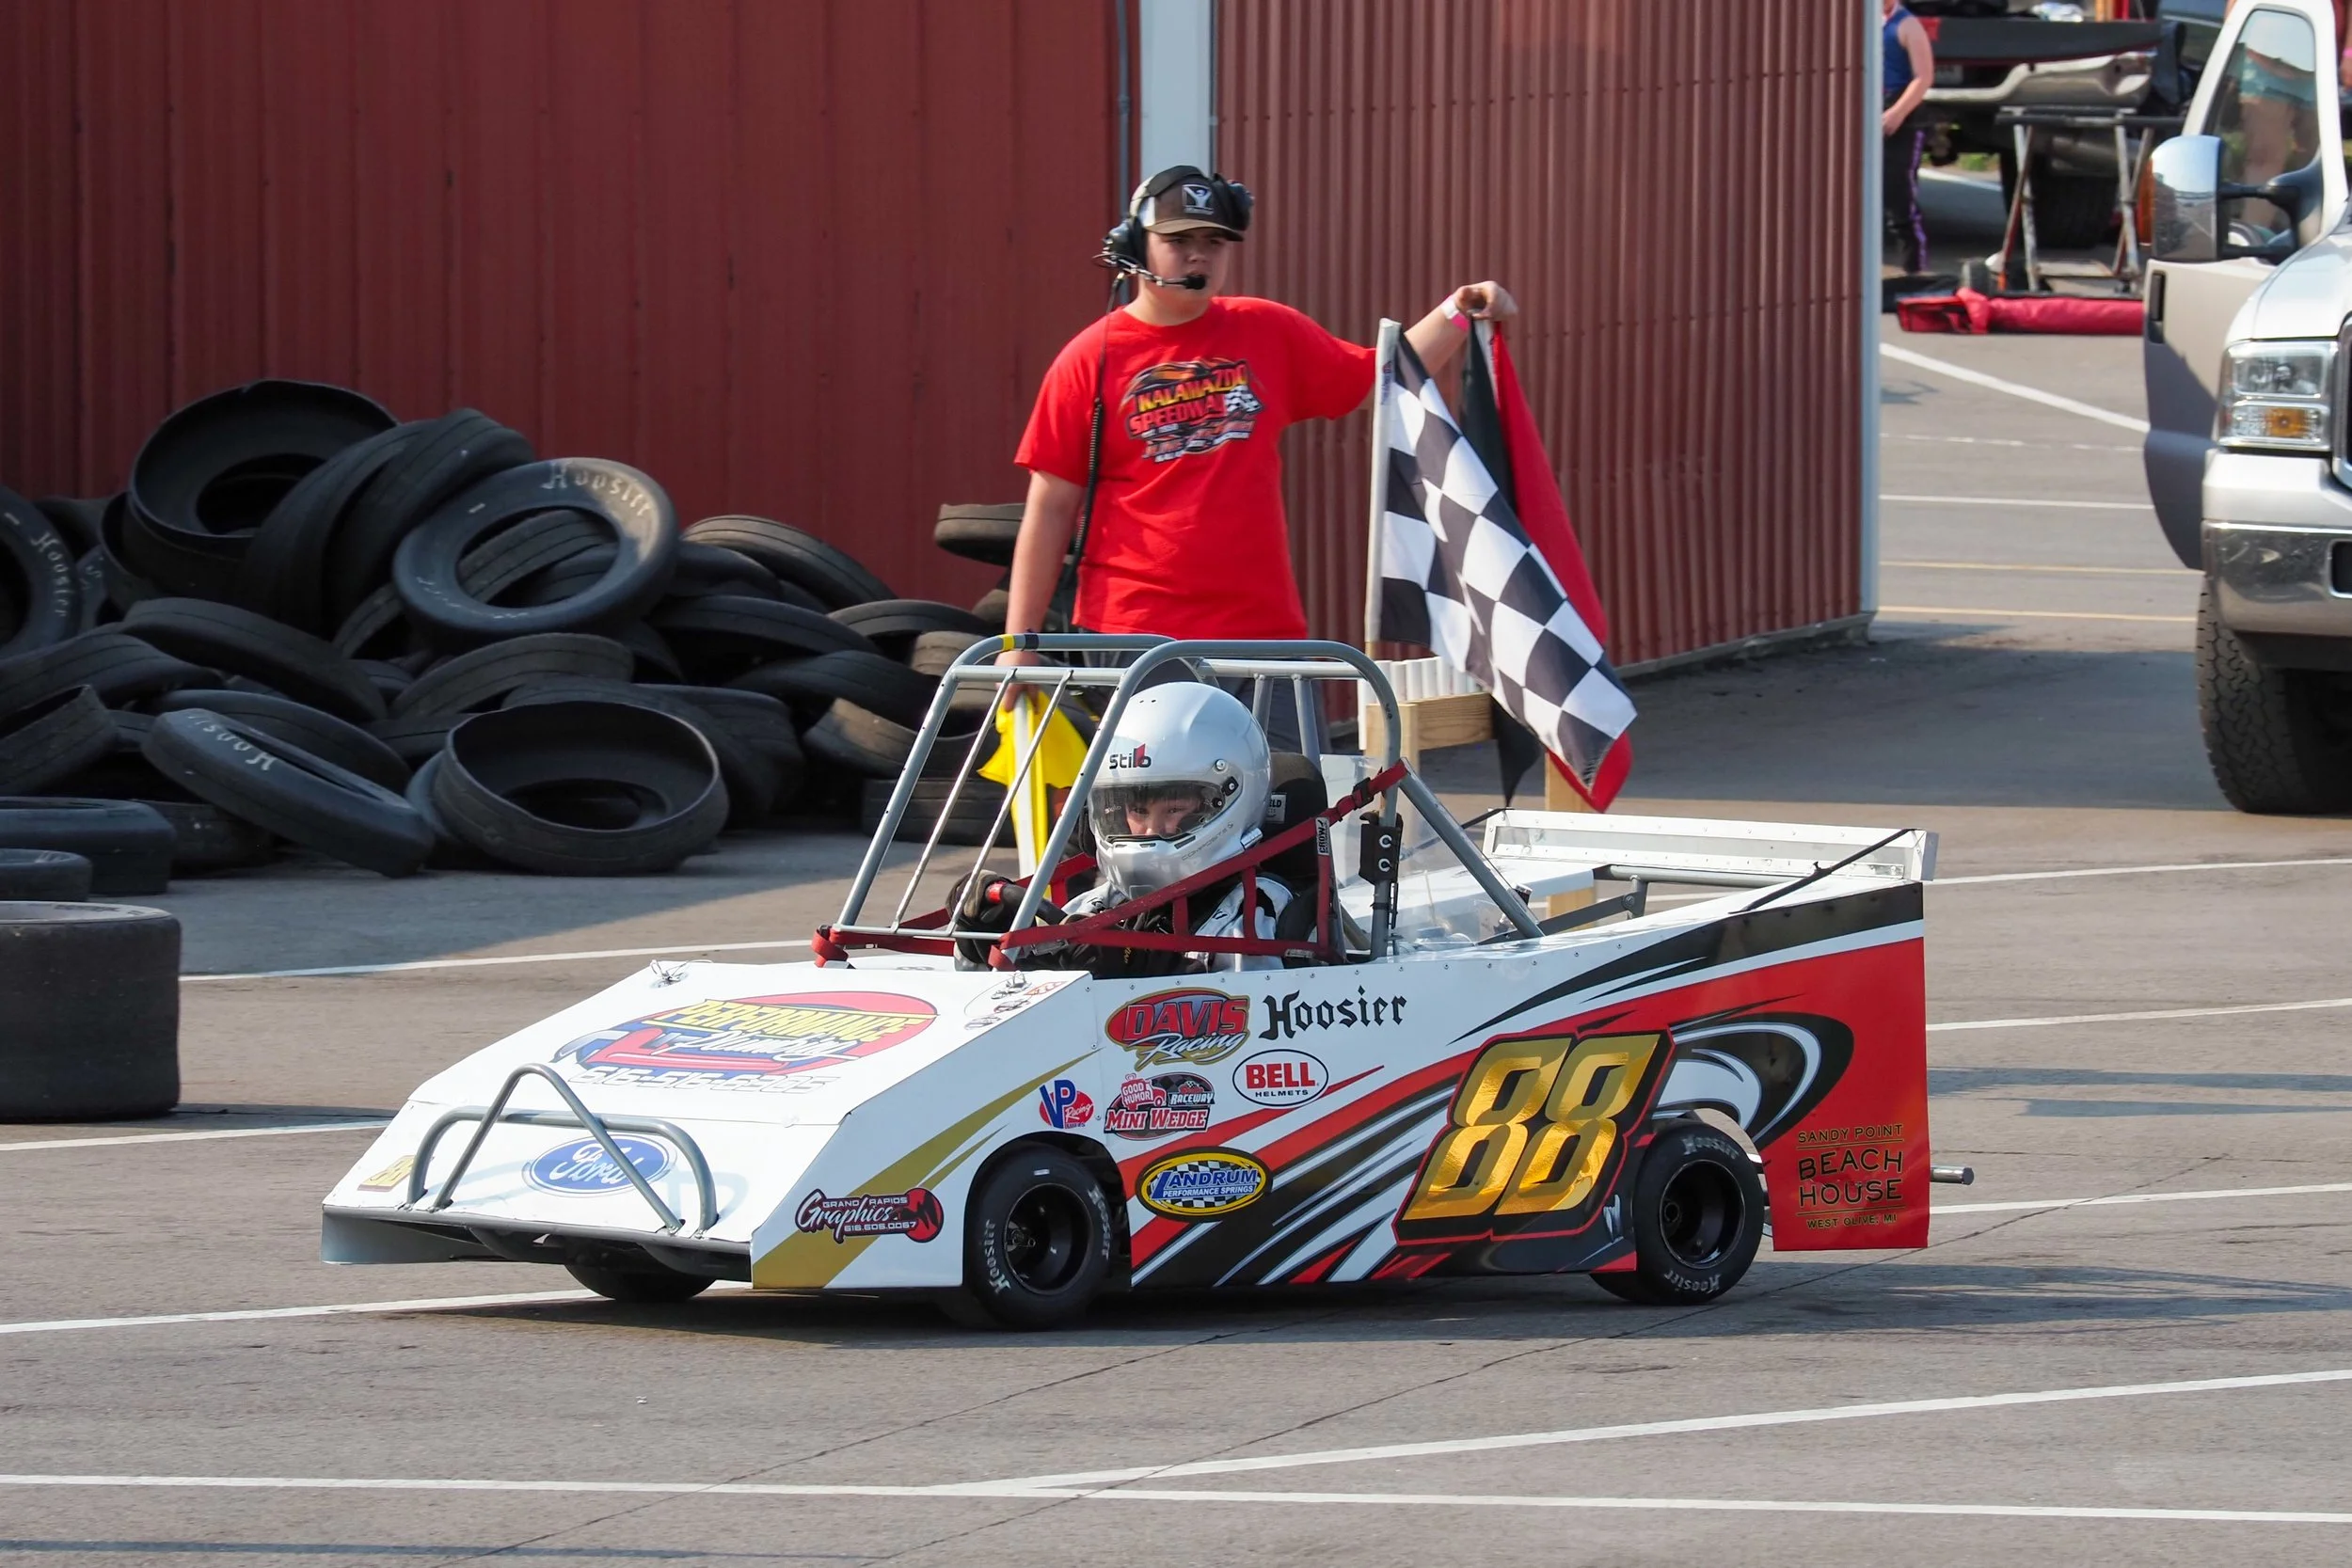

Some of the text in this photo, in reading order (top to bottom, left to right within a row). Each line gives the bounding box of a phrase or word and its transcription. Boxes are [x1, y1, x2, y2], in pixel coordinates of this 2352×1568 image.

[30, 531, 73, 617] Hoosier
[653, 999, 926, 1042] PERFORMANCE
[1122, 999, 1248, 1041] DAVIS
[1258, 985, 1407, 1040] Hoosier
[1129, 1032, 1248, 1068] Racing
[1122, 1083, 1145, 1096] GOOD
[1245, 1062, 1316, 1089] BELL
[1039, 1079, 1076, 1129] VP
[1124, 1091, 1151, 1106] HUMOR
[1170, 1092, 1214, 1105] RACEWAY
[1255, 1089, 1309, 1098] HELMETS
[1402, 1034, 1661, 1221] 88
[1798, 1124, 1903, 1143] SANDY POINT
[548, 1143, 645, 1184] Ford
[1798, 1148, 1903, 1180] BEACH
[1152, 1169, 1258, 1199] LANDRUM
[1163, 1185, 1254, 1198] PERFORMANCE SPRINGS
[1799, 1179, 1903, 1207] HOUSE
[798, 1191, 894, 1240] Graphics
[822, 1196, 909, 1209] GRAND RAPIDS
[1807, 1219, 1838, 1229] WEST
[1883, 1213, 1898, 1223] MI
[1663, 1270, 1722, 1294] Hoosier
